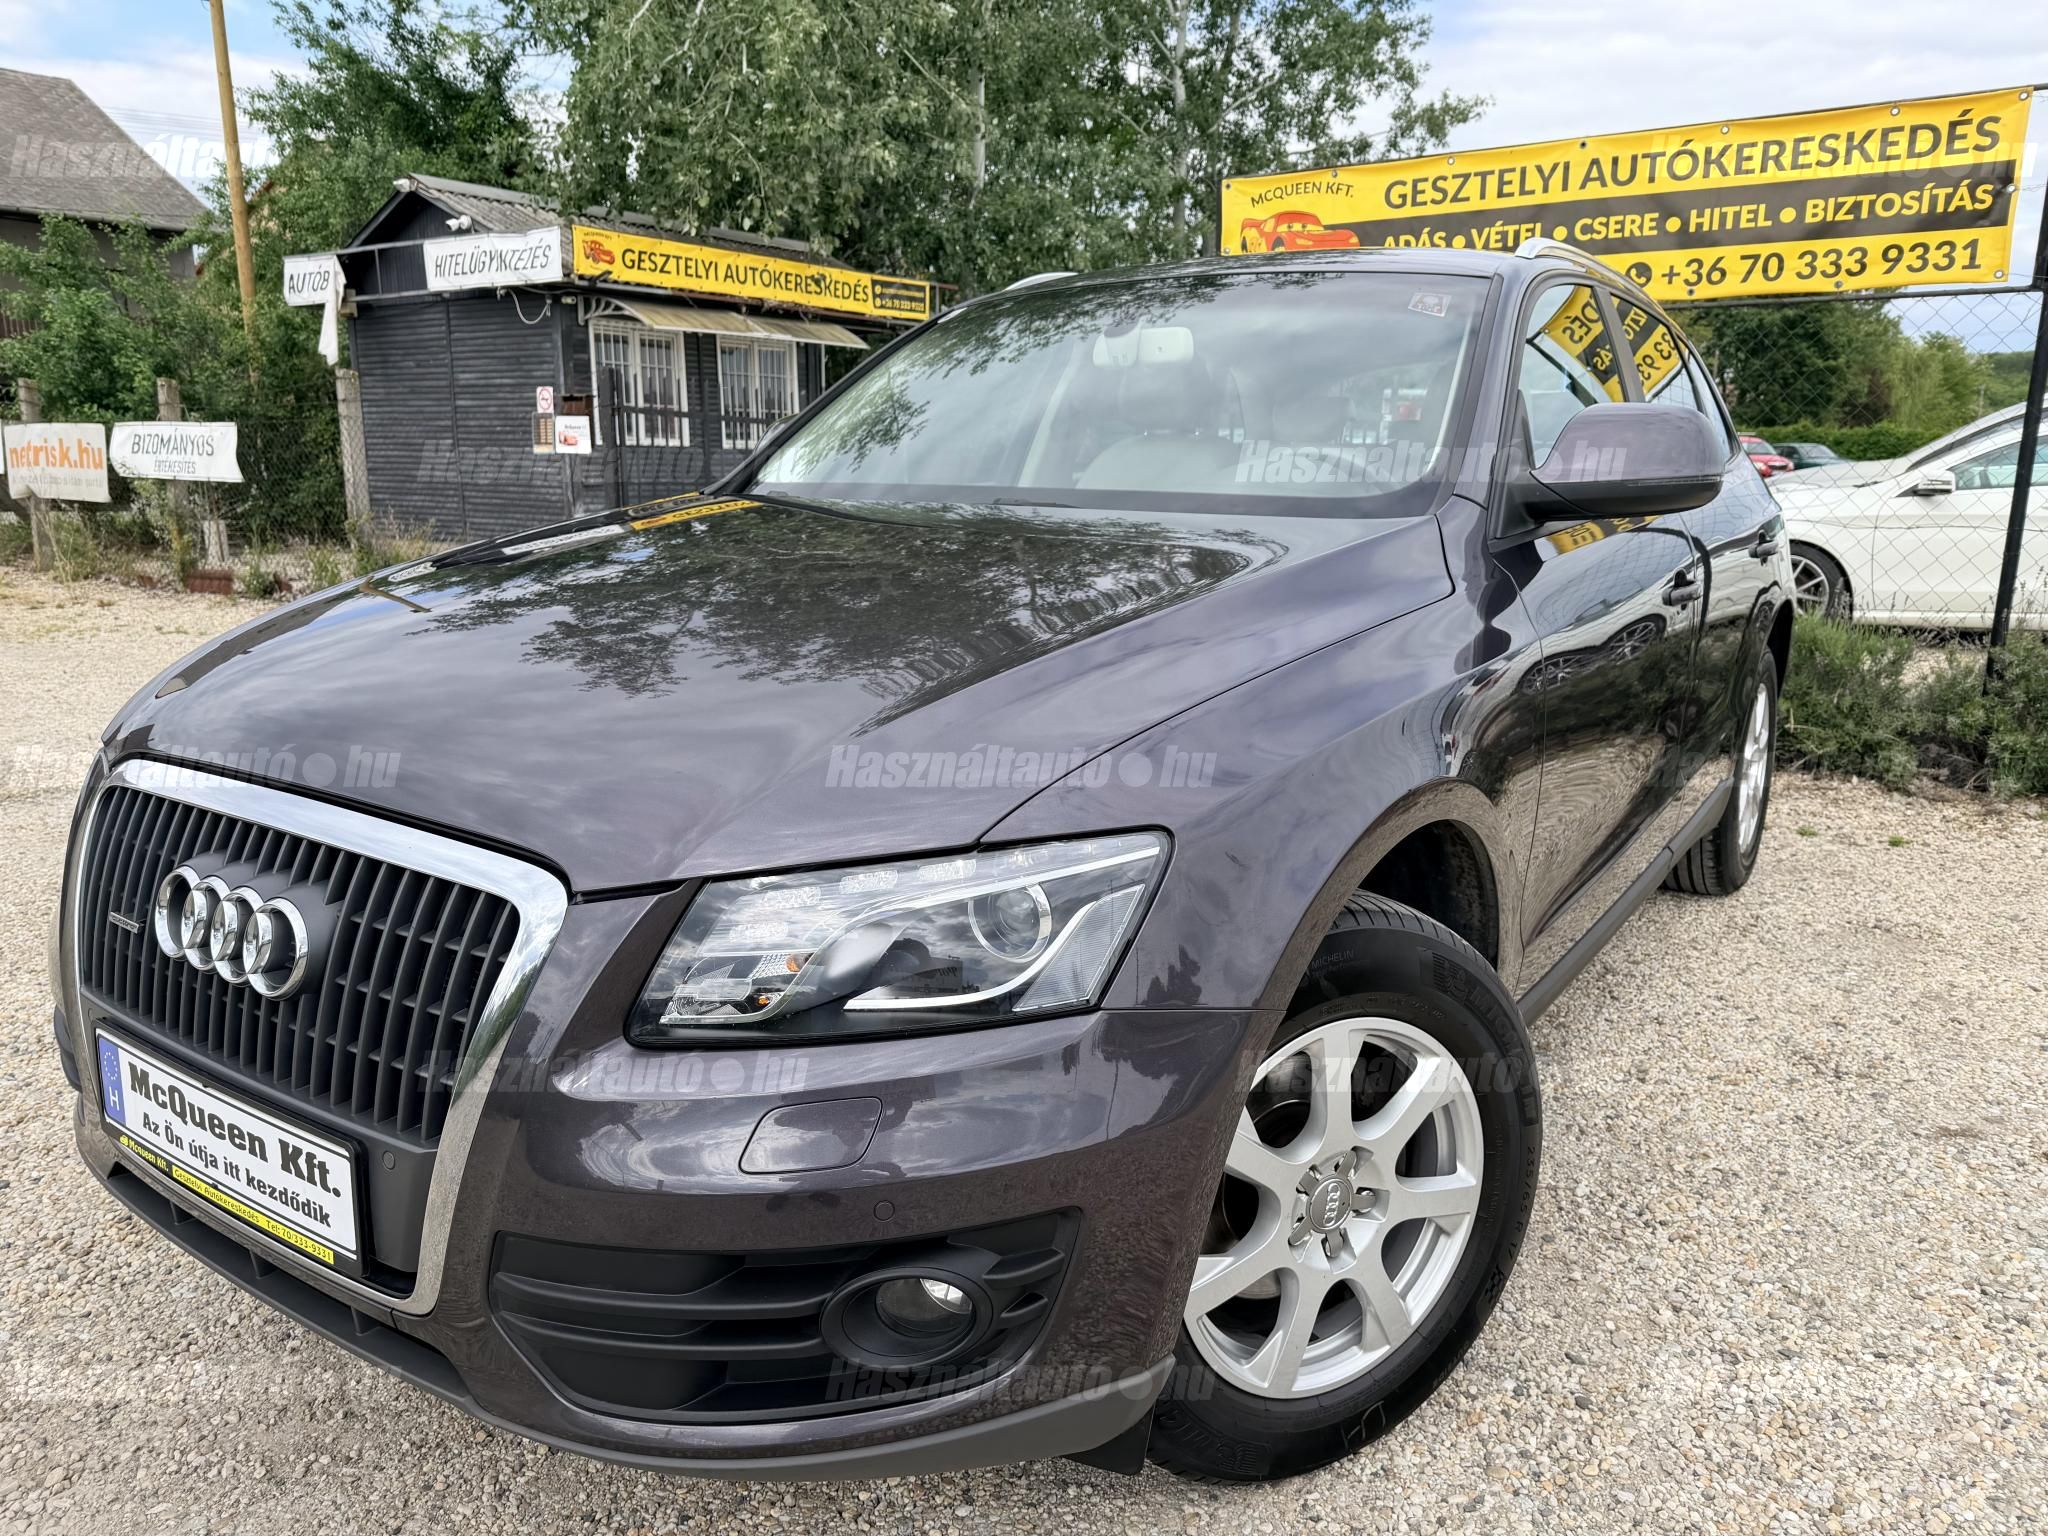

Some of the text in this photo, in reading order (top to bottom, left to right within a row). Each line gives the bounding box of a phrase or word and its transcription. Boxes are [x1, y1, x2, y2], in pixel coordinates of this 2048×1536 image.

[1384, 108, 2002, 209] GESZTELYI AUTÓKERESKEDÉS
[1250, 181, 1355, 208] MCQUEEN KFT.
[1574, 212, 1659, 241] CSERE
[1689, 203, 1772, 233] HITEL
[1805, 180, 1994, 224] BIZTOSÍTÁS
[288, 265, 331, 294] AUTÓB
[622, 248, 869, 303] GESZTELYI AUTÓKERESKEDÉS
[1661, 238, 1982, 288] +36 70 333 9331
[9, 437, 104, 470] netrisk.hu
[131, 428, 214, 457] BIZOMÁNYOS
[109, 1086, 120, 1111] H
[128, 1061, 342, 1198] McQueen Kft.
[143, 1112, 331, 1228] Az Ön útja itt kezdődik
